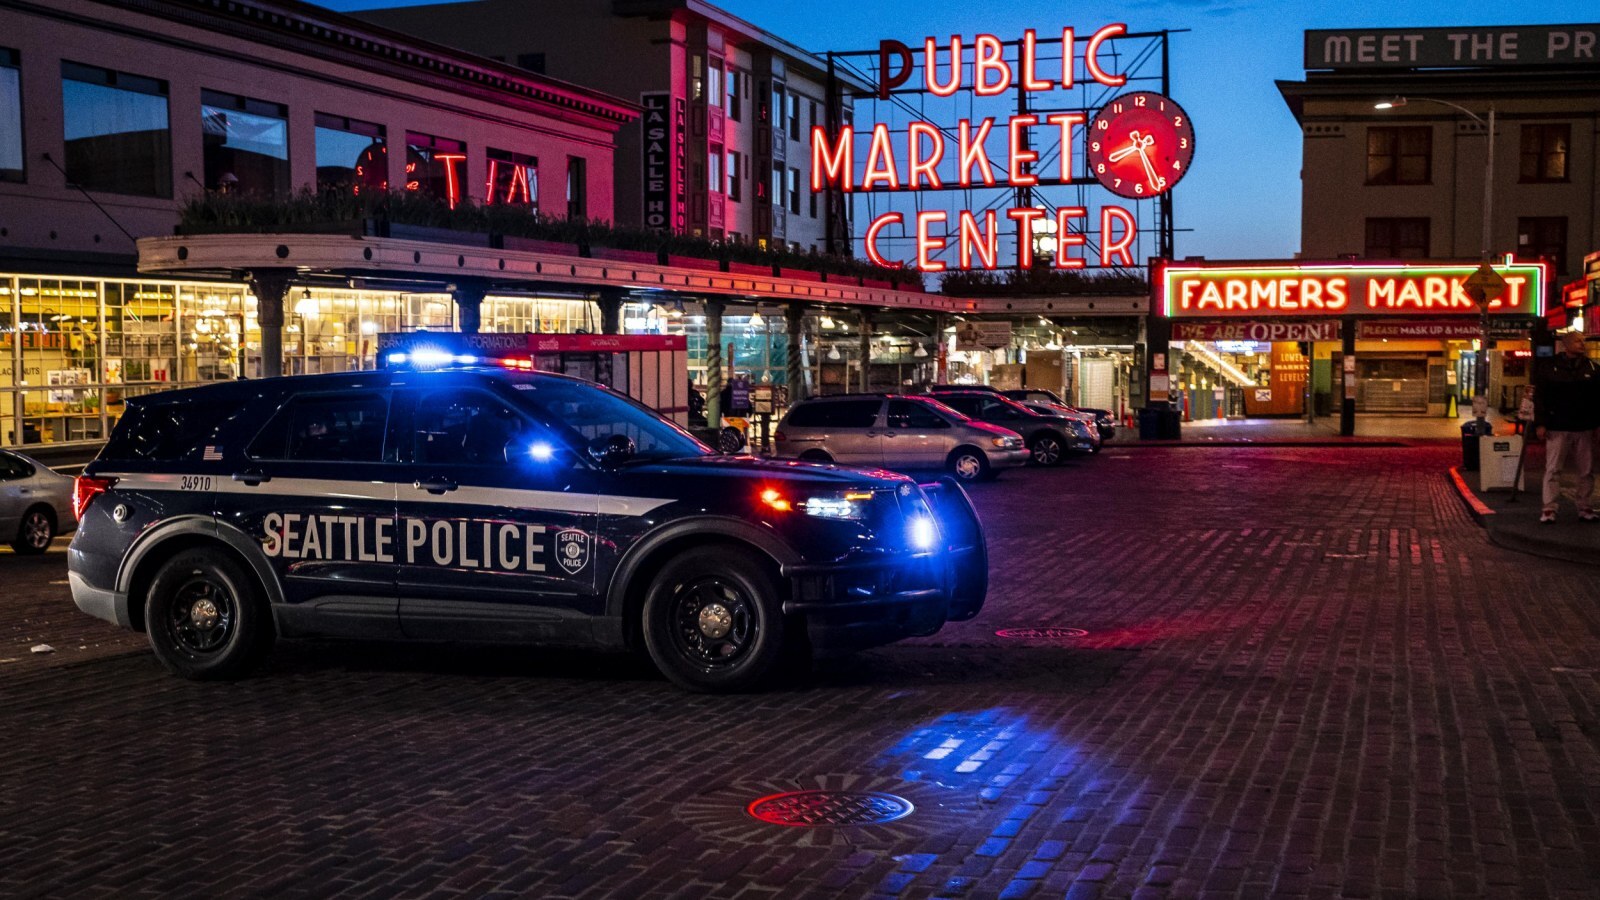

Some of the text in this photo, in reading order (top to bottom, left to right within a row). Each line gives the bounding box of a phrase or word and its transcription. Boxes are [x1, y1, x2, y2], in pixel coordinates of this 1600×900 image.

[1324, 35, 1424, 63] MEET
[1448, 32, 1519, 61] THE
[879, 23, 1127, 100] PUBLIC
[1134, 96, 1146, 107] 12
[1160, 101, 1164, 111] 1
[648, 98, 664, 122] LA
[677, 100, 685, 126] LA
[1113, 103, 1123, 114] 11
[1097, 120, 1108, 130] 10
[1174, 116, 1182, 127] 2
[1092, 142, 1100, 152] 9
[1179, 138, 1187, 149] 3
[811, 113, 1089, 192] MARKET
[648, 127, 665, 192] SALLE
[677, 132, 685, 195] SALLE
[1097, 163, 1106, 174] 8
[1172, 160, 1181, 171] 4
[1114, 178, 1122, 188] 7
[1158, 176, 1167, 187] 5
[1134, 183, 1143, 194] 6
[864, 205, 1137, 272] CENTER
[1181, 277, 1526, 309] FARMERS MARKT
[1180, 323, 1330, 340] WE ARE OPEN!
[1363, 326, 1398, 335] PLEASE
[1400, 325, 1429, 335] MASK
[1430, 325, 1443, 335] UP
[1454, 325, 1480, 335] MAIN
[463, 335, 517, 349] INFORMATION
[1279, 373, 1306, 382] LEVELS
[181, 475, 212, 491] 34910
[263, 512, 547, 572] SEATTLE POLICE
[561, 533, 585, 543] SEATTLE
[563, 557, 582, 567] POLICE
